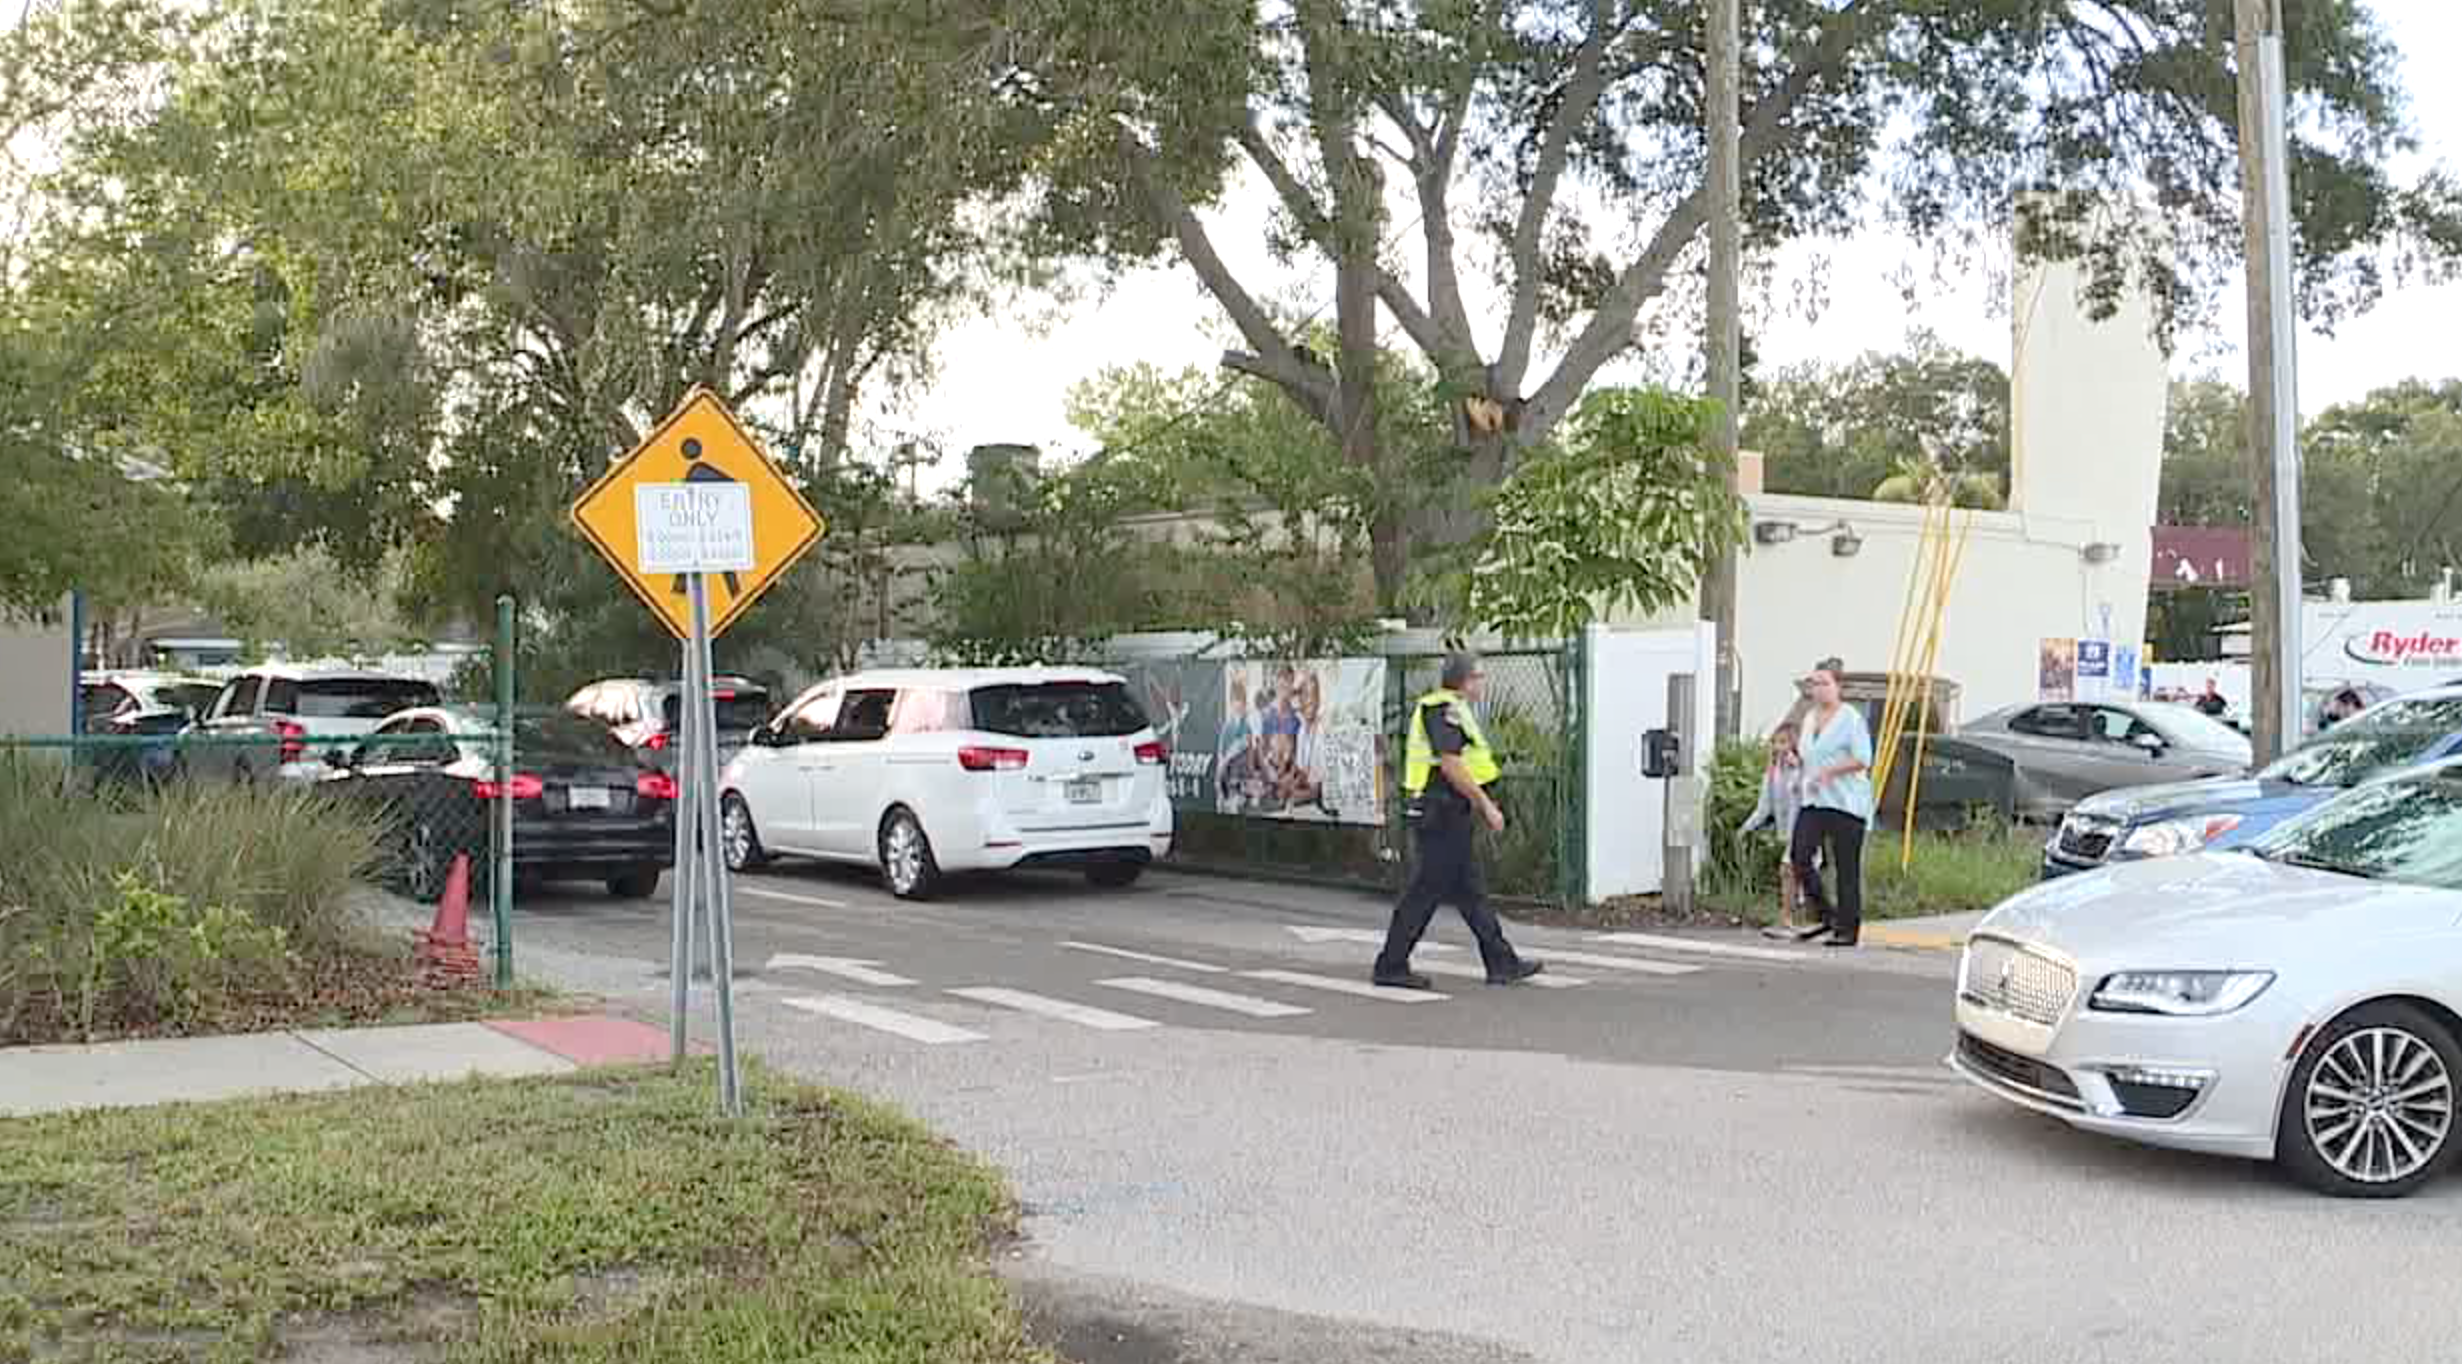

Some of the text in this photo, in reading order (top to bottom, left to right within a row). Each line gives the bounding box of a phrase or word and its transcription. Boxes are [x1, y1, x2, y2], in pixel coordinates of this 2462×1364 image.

[660, 491, 719, 510] ENTRY
[670, 510, 719, 526] ONLY
[2371, 631, 2460, 657] Ryder
